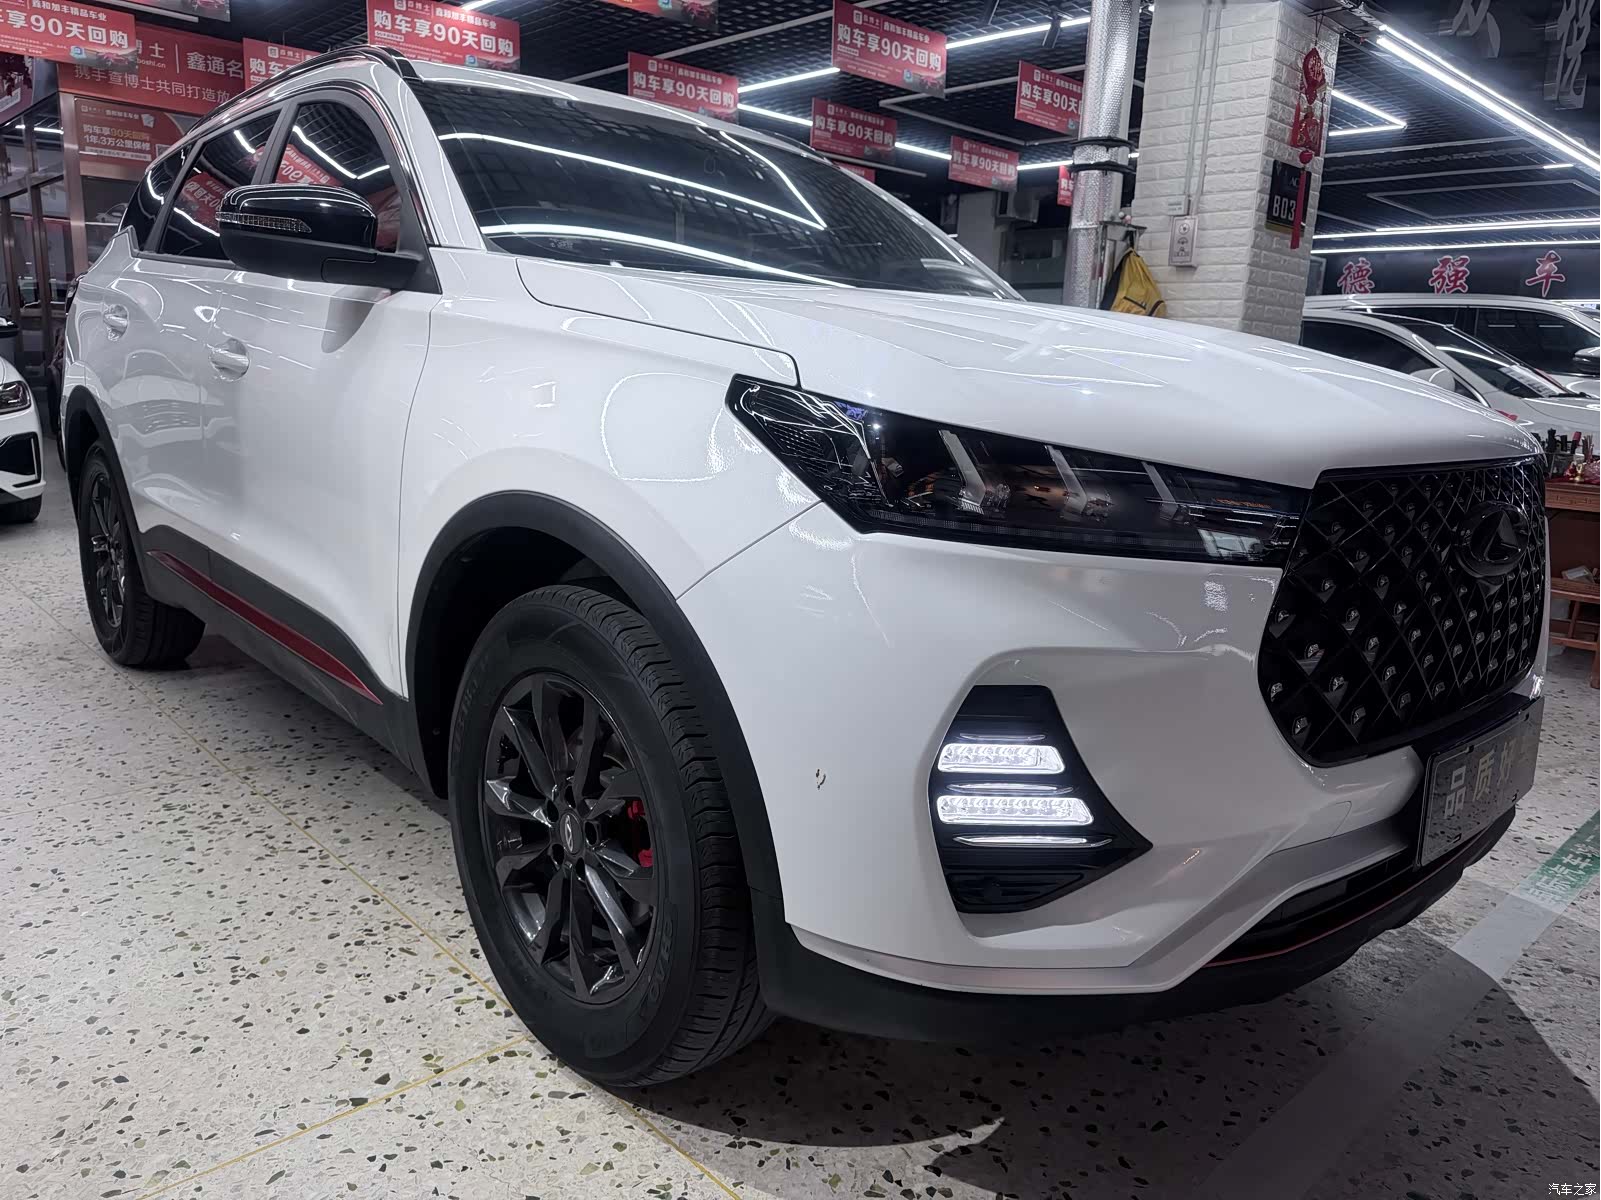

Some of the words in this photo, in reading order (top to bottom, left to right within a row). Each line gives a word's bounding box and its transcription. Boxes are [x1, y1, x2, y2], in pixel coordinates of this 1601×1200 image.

[0, 8, 128, 48] 享90天回购
[374, 9, 514, 57] 购车享90天回购
[837, 23, 942, 71] 购车享90天回购
[249, 57, 294, 75] 购车
[633, 71, 735, 108] 购车享90天回购
[1021, 81, 1081, 115] 购车享90天
[815, 115, 894, 147] 购车享90天回购
